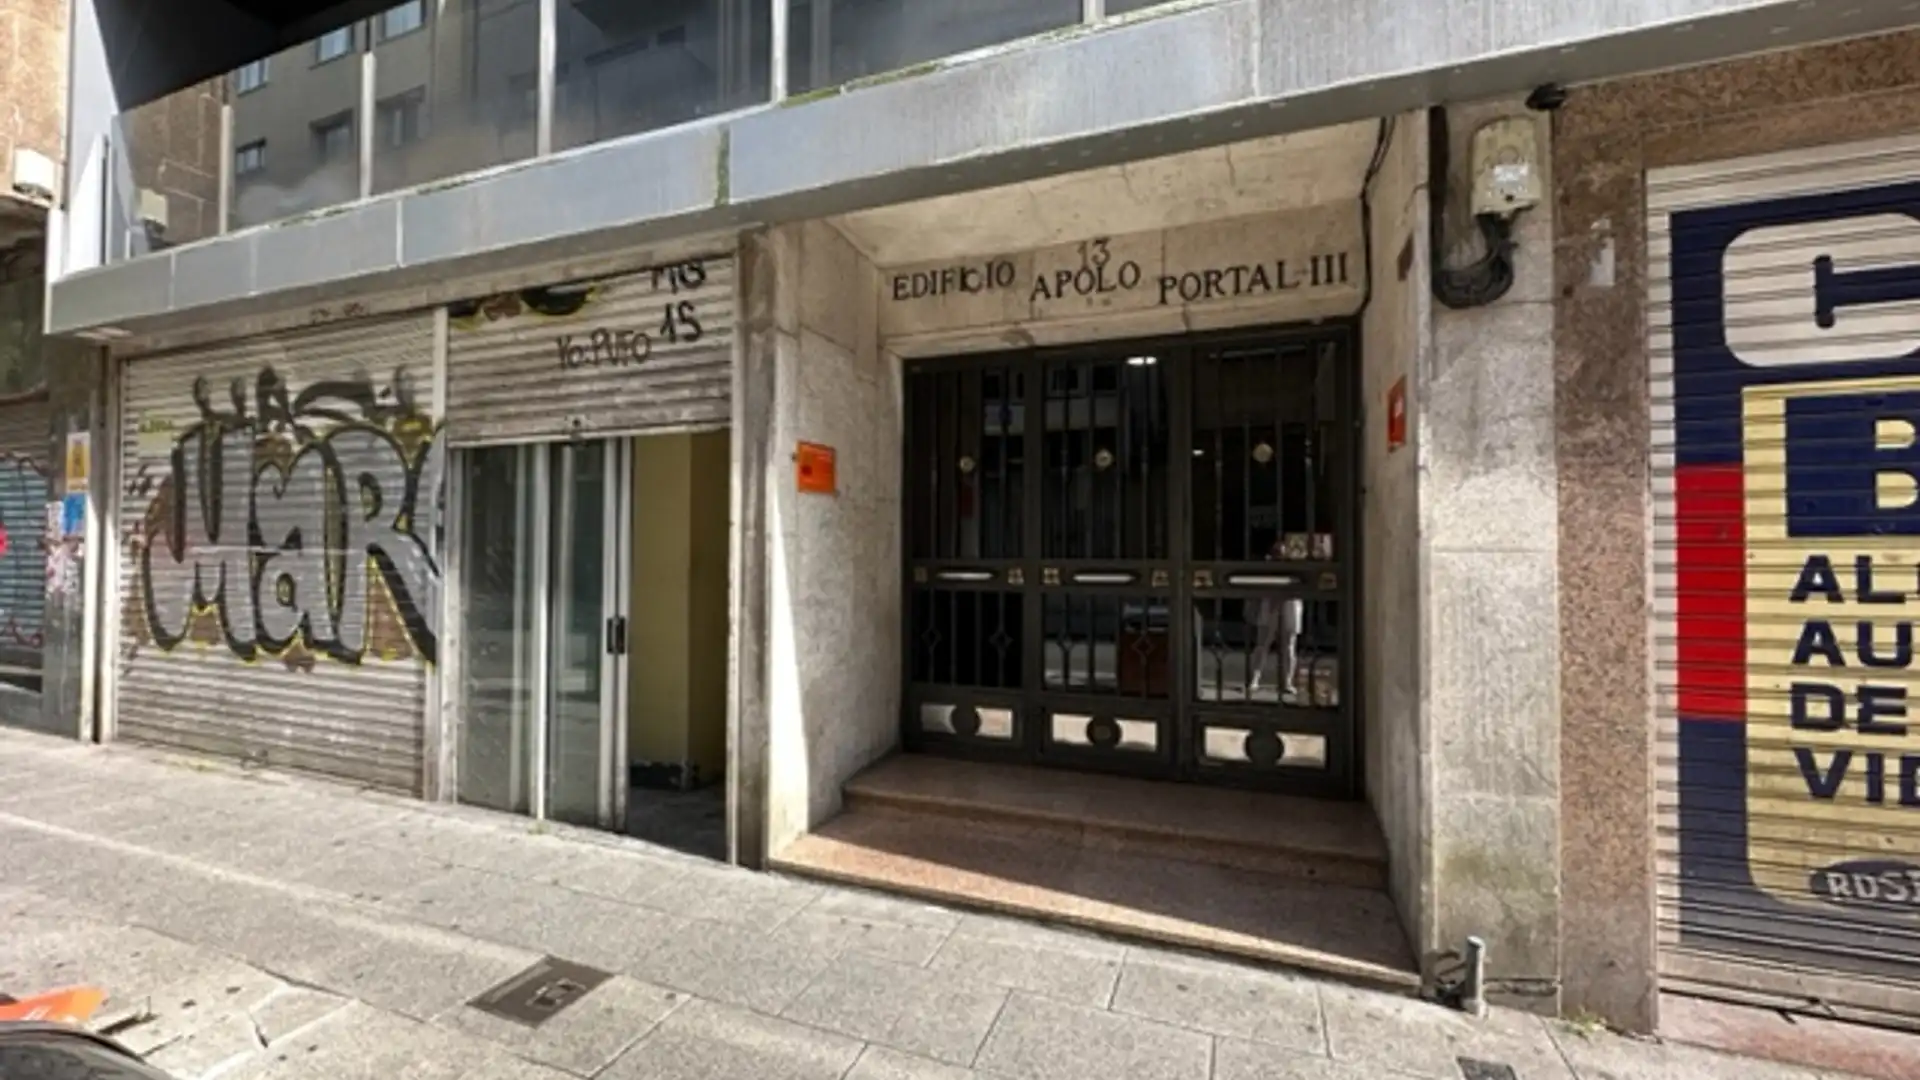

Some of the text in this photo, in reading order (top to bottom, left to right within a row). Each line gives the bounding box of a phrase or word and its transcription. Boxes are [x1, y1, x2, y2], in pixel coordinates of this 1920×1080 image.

[1077, 236, 1111, 267] 13
[892, 260, 1016, 301] EDIFICIO
[1030, 260, 1142, 301] APOLO
[1788, 554, 1920, 604] AL
[1791, 620, 1909, 669] AU
[1789, 682, 1908, 736] DE
